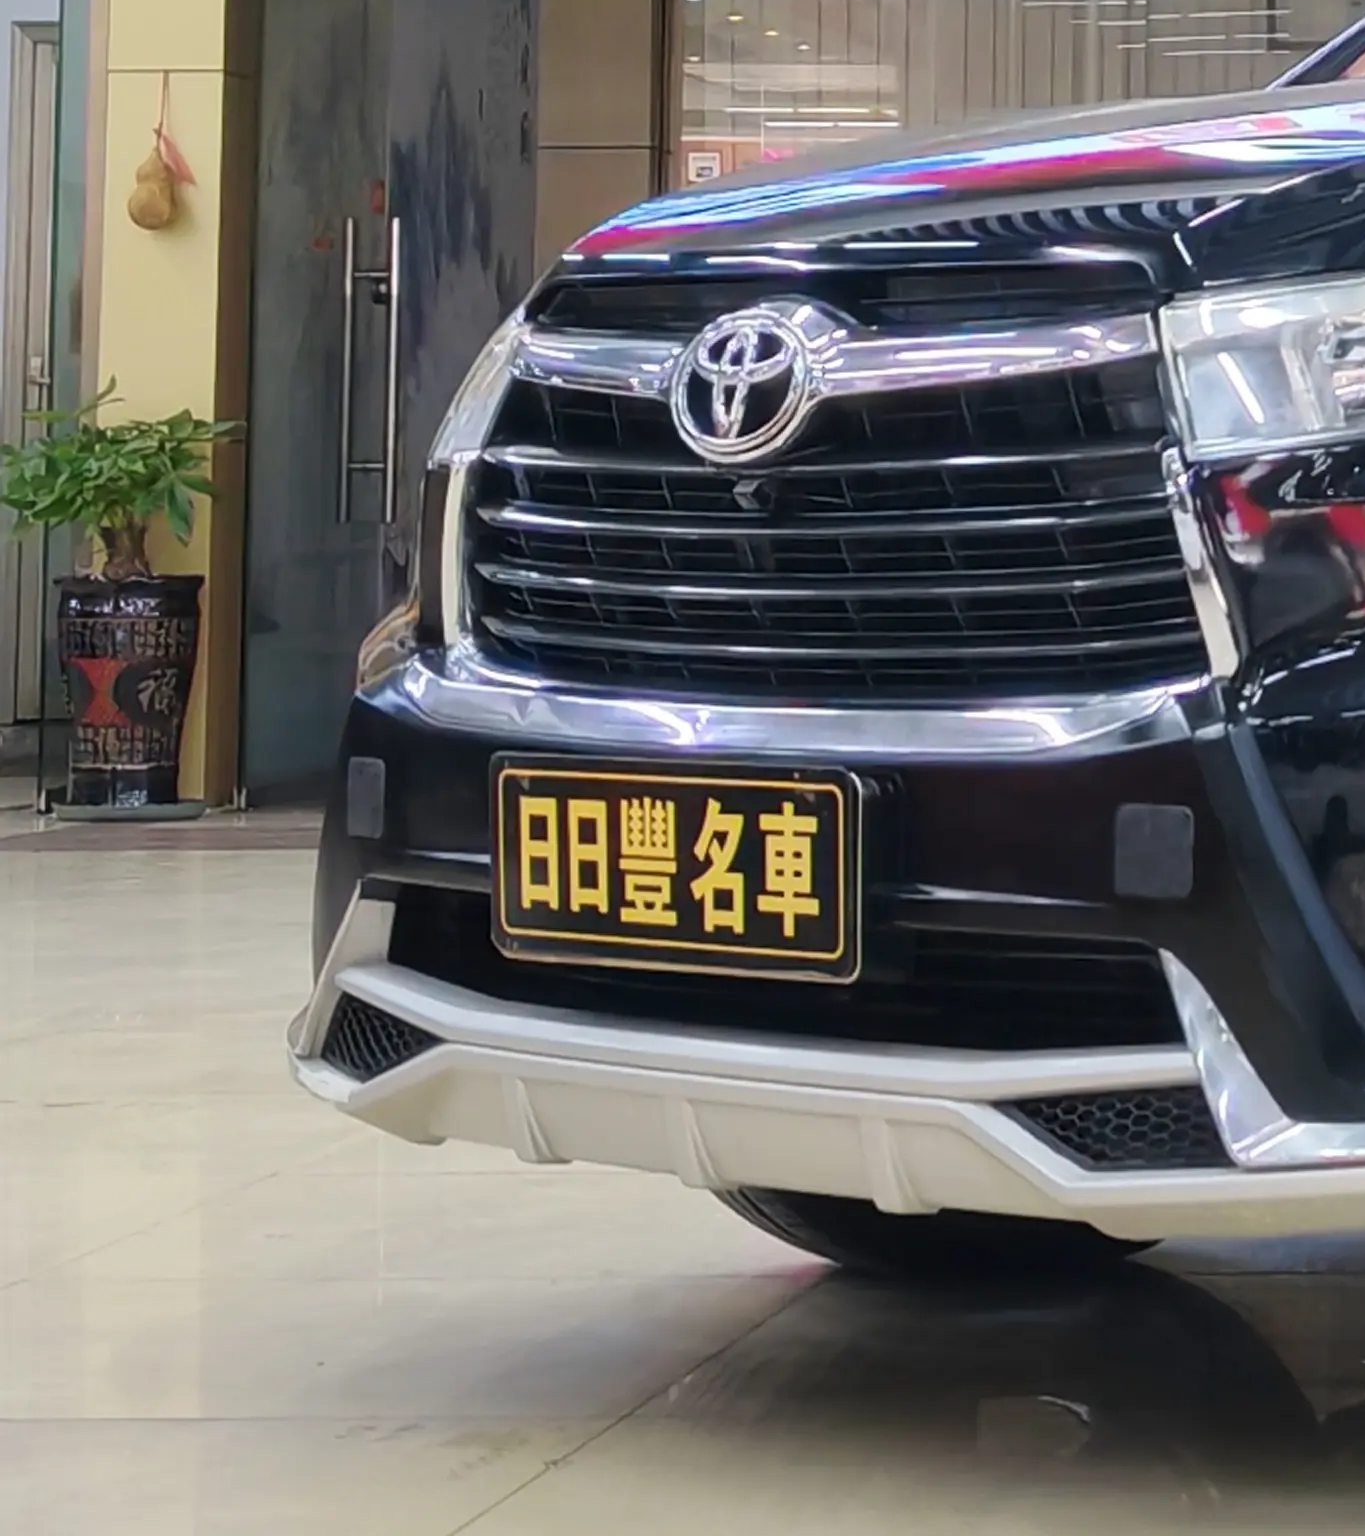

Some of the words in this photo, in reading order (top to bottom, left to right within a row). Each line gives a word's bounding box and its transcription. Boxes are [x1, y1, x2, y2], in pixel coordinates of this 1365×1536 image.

[518, 795, 821, 939] 日日豐名車
